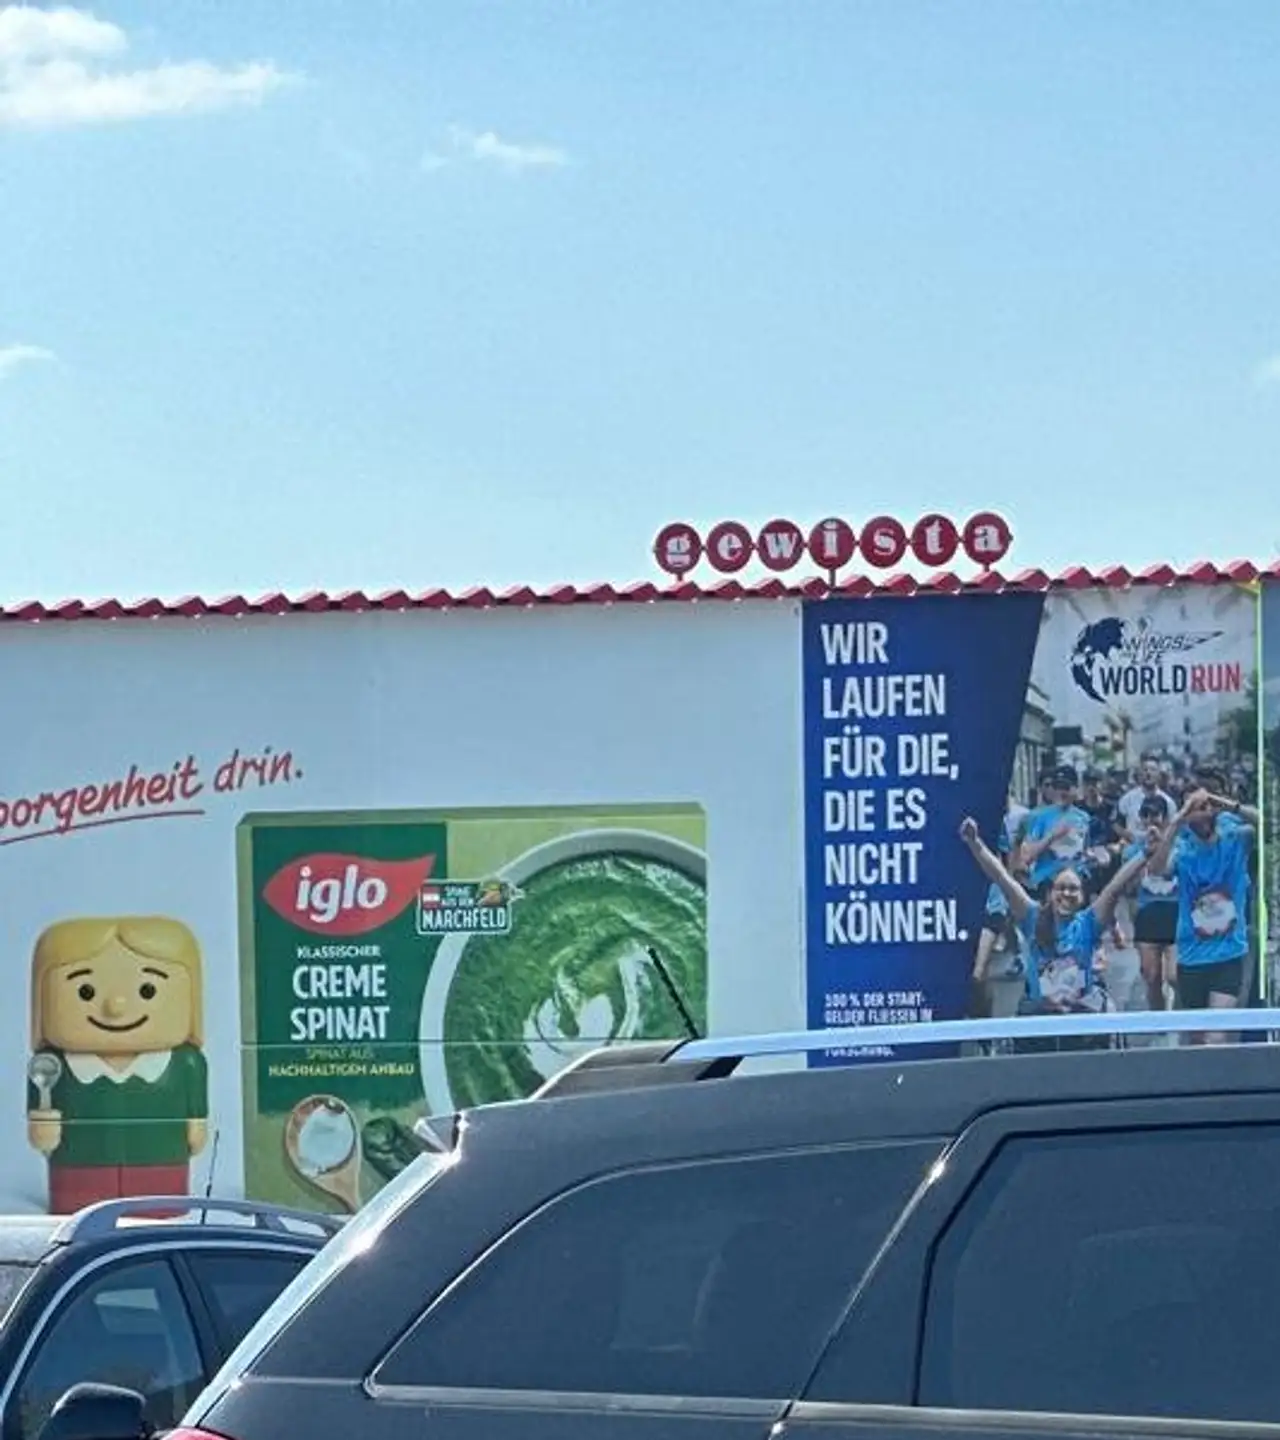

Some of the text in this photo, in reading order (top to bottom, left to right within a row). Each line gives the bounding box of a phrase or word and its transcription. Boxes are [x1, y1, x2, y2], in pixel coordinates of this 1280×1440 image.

[666, 520, 1001, 568] gewista
[820, 621, 889, 665] WIR
[1123, 634, 1185, 652] WINGS
[822, 674, 946, 719] LAUFEN
[1100, 661, 1241, 696] WORLD RUN
[214, 745, 303, 793] drin.
[823, 724, 960, 781] FÜR DIE,
[823, 787, 927, 832] DIE ES
[824, 842, 923, 886] NICHT
[296, 863, 388, 923] iglo
[422, 908, 506, 930] MARCHFELD
[825, 890, 969, 945] KÖNNEN.
[292, 964, 388, 1000] CREME
[290, 1005, 391, 1041] SPINAT
